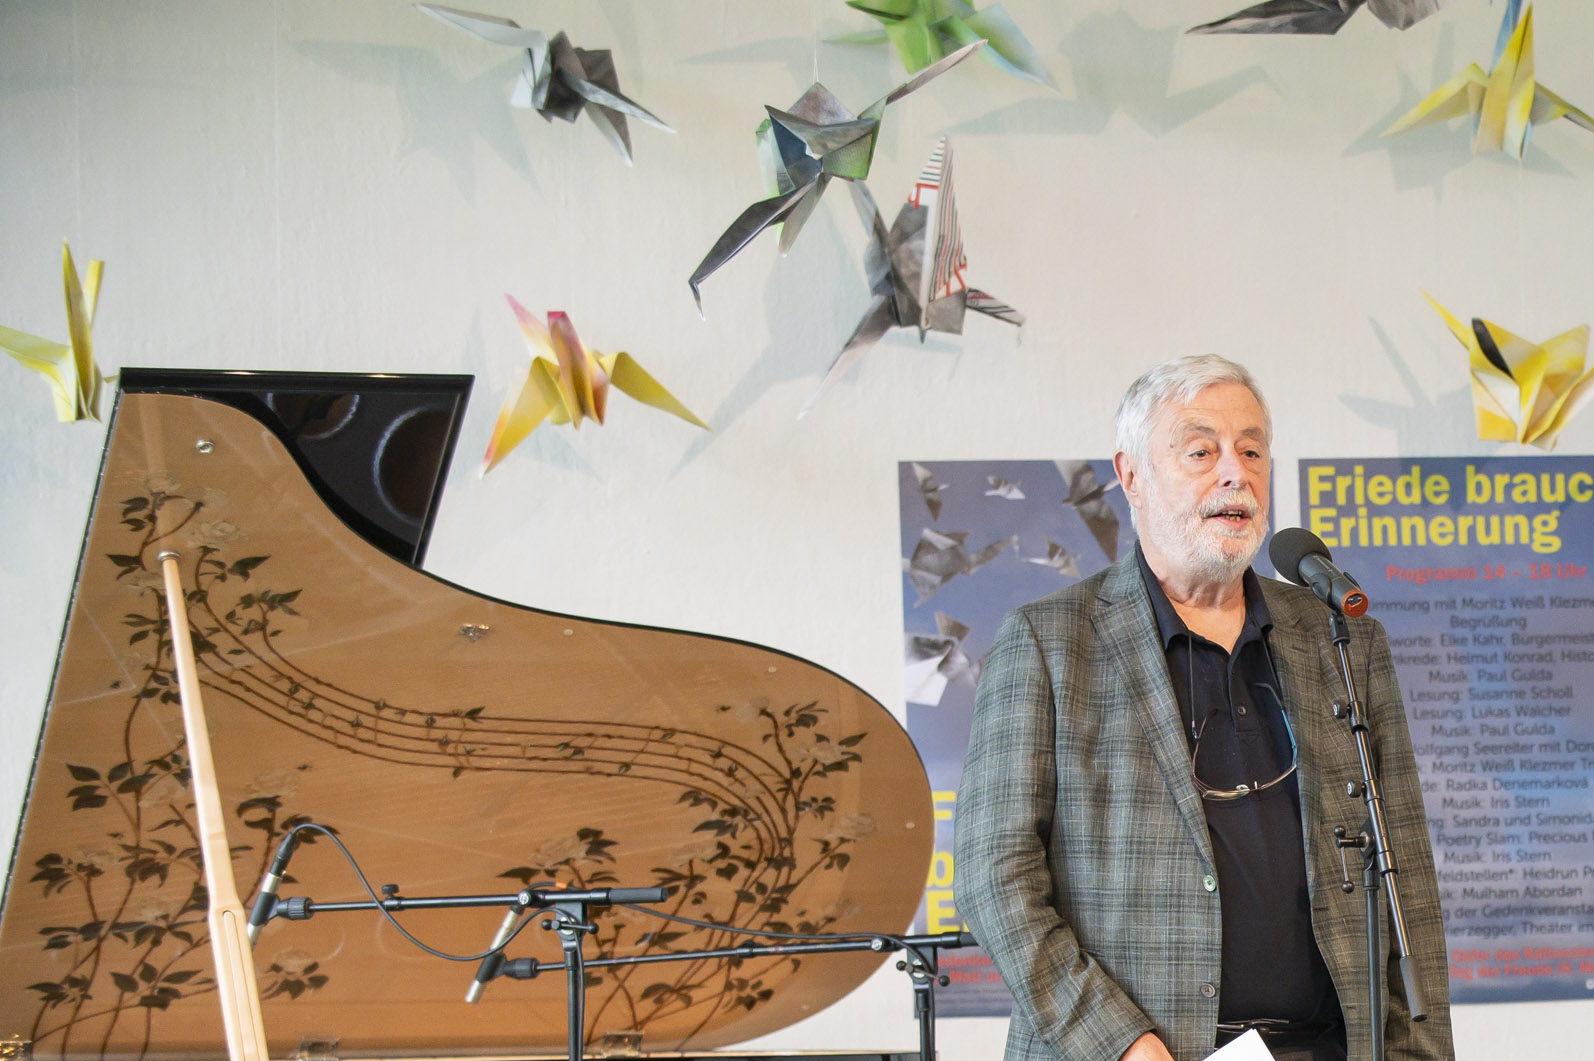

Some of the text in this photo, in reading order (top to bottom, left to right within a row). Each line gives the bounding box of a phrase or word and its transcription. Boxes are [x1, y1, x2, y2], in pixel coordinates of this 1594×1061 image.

[1308, 465, 1449, 506] Friede
[1310, 507, 1561, 554] Erinnerung
[1385, 565, 1477, 586] Programm
[1482, 563, 1505, 581] 14
[1528, 562, 1551, 580] 18
[1556, 562, 1587, 580] Uhr
[1371, 598, 1430, 614] immung
[1434, 598, 1456, 611] mit
[1461, 597, 1505, 610] Moritz
[1389, 634, 1434, 648] worte:
[1440, 633, 1468, 647] Elke
[1446, 651, 1498, 665] Helmut
[1478, 668, 1507, 682] Paul
[1511, 668, 1553, 682] Gulda
[1468, 686, 1526, 701] Susanne
[1531, 685, 1573, 700] Scholl
[1471, 705, 1511, 720] Lukas
[1514, 704, 1571, 719] Walcher
[1480, 722, 1509, 737] Paul
[1513, 721, 1555, 736] Gulda
[1539, 741, 1561, 754] mit
[1432, 761, 1476, 774] Moritz
[1519, 758, 1576, 773] Klezmer
[1446, 778, 1488, 792] Radka
[1490, 795, 1510, 809] Iris
[1514, 794, 1550, 809] Stern
[1453, 813, 1501, 829] Sandra
[1504, 812, 1531, 827] und
[1436, 832, 1482, 849] Poetry
[1528, 830, 1588, 845] Precious
[1492, 850, 1512, 864] Iris
[1516, 848, 1552, 863] Stern
[1523, 866, 1579, 881] Heidrun
[1454, 905, 1478, 920] der
[1520, 920, 1573, 935] Theater
[1577, 922, 1594, 933] im
[1449, 964, 1474, 982] Tag
